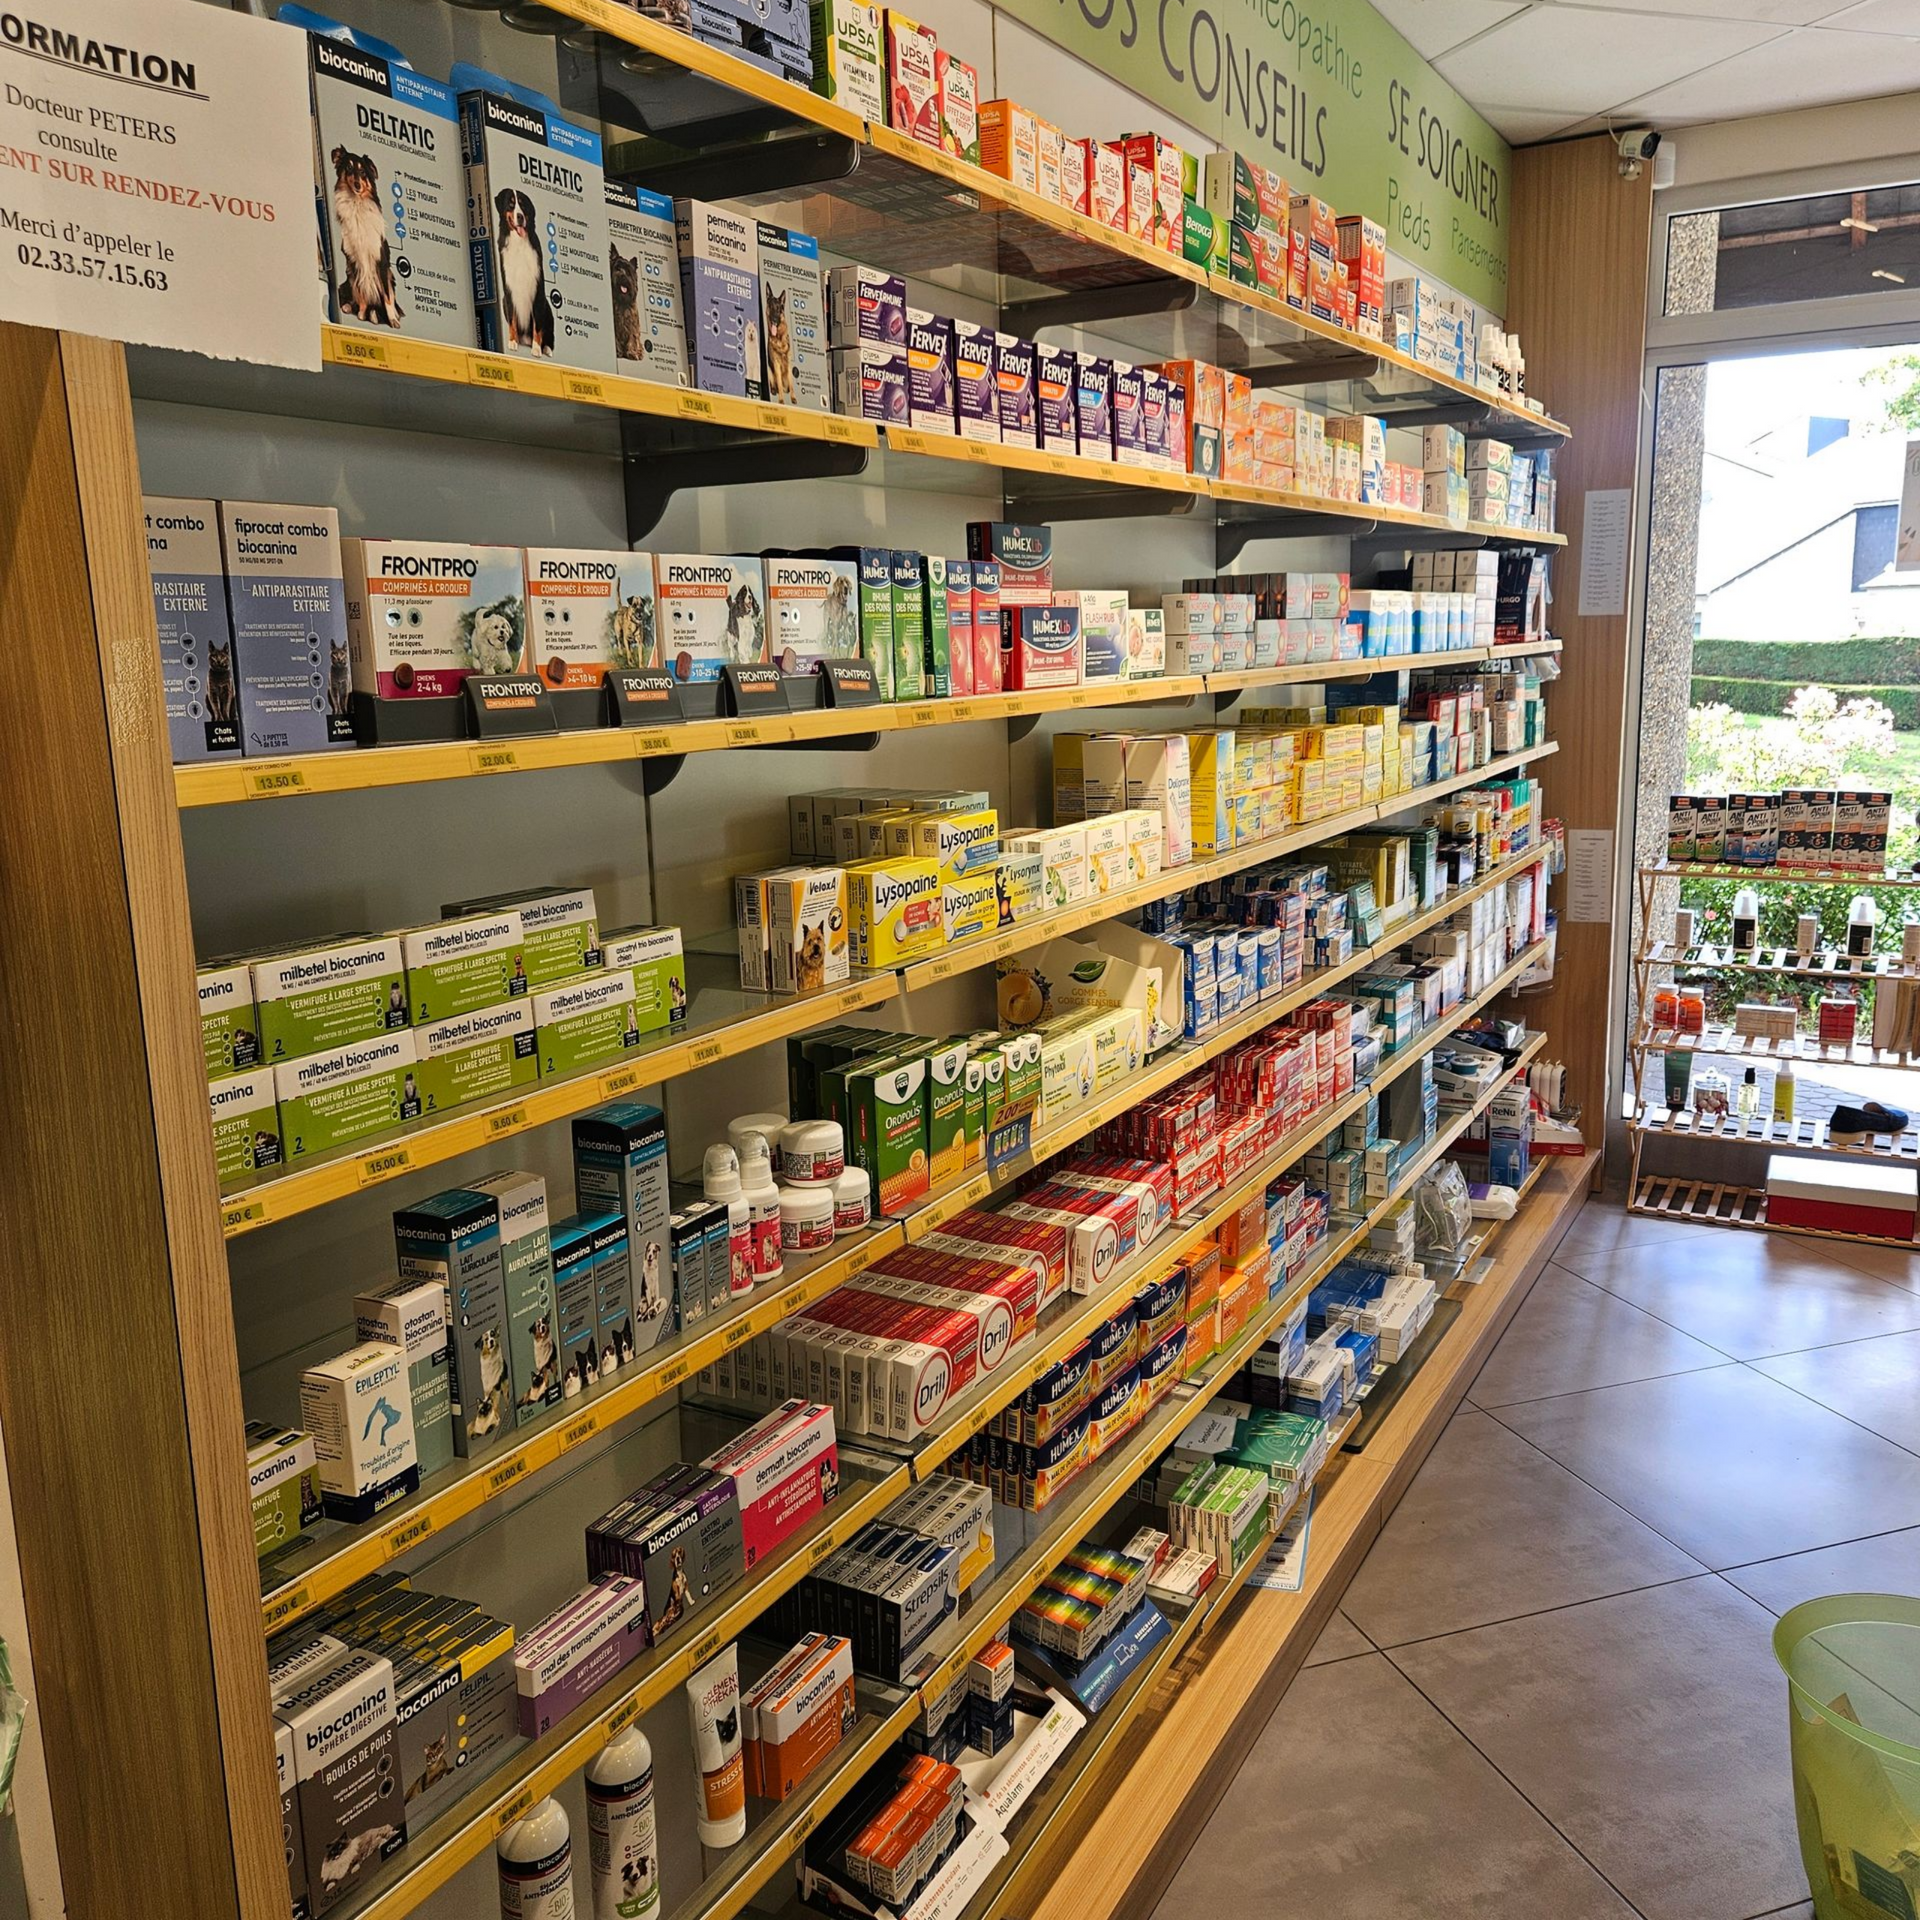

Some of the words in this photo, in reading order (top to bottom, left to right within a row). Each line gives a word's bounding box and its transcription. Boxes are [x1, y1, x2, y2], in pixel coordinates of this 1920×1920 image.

[837, 21, 876, 50] UPSA
[318, 45, 387, 86] biocanina
[900, 41, 930, 67] UPSA
[395, 75, 447, 101] ANTIPARASITAIRE
[397, 83, 424, 100] EXTERNE
[948, 80, 971, 101] UPSA
[1158, 0, 1327, 177] CONSEILS
[5, 83, 83, 123] Docteur
[89, 106, 177, 145] PETERS
[488, 101, 543, 136] biocanina
[356, 103, 435, 151] DELTATIC
[38, 130, 118, 163] consulte
[1388, 79, 1410, 155] SE
[1418, 106, 1498, 227] SOIGNER
[518, 153, 584, 193] DELTATIC
[49, 159, 98, 188] SUR
[101, 170, 276, 222] RENDEZ-VOUS
[418, 210, 456, 229] MOUSTIQUES
[707, 213, 746, 235] permetrix
[1388, 177, 1431, 251] Pieds
[0, 208, 57, 239] Merci
[157, 240, 175, 262] le
[609, 218, 642, 237] PERMETRIX
[643, 227, 673, 244] BIOCANINA
[1185, 215, 1211, 239] Berocca
[708, 229, 746, 253] biocanina
[1452, 217, 1507, 285] Pansements
[17, 244, 169, 292] 02.33.57.15.63
[703, 265, 752, 288] ANTIPARASITAIRES
[727, 283, 752, 300] EXTERNES
[345, 344, 367, 357] 9.60
[368, 350, 376, 359] €
[479, 367, 502, 381] 25.00
[156, 516, 205, 532] combo
[234, 518, 284, 538] fiprocat
[287, 523, 328, 538] combo
[237, 538, 297, 556] biocanina
[1002, 536, 1031, 552] HUMEX
[381, 555, 476, 578] FRONTPRO
[539, 561, 616, 580] FRONTPRO
[669, 565, 732, 583] FRONTPRO
[777, 569, 832, 584] FRONTPRO
[863, 565, 889, 580] HUMEX
[895, 567, 921, 580] HUMEX
[252, 584, 329, 598] ANTIPARASITAIRE
[382, 581, 427, 594] COMPRIMÉS
[428, 582, 434, 593] À
[435, 582, 468, 593] CROQUER
[872, 593, 890, 602] RHUME
[1500, 595, 1520, 603] URGO
[164, 599, 208, 612] EXTERNE
[293, 599, 331, 612] EXTERNE
[865, 603, 874, 613] DES
[875, 602, 891, 613] FOINS
[417, 683, 431, 693] 2-4
[432, 682, 442, 694] kg
[643, 739, 661, 751] 38.00
[734, 728, 750, 740] 43.00
[481, 754, 505, 768] 32.00
[505, 754, 512, 764] €
[259, 774, 289, 790] 13.50
[291, 774, 300, 786] €
[1168, 778, 1189, 790] Doliprane
[941, 821, 995, 850] Lysopaïne
[424, 932, 464, 952] milbetel
[465, 923, 509, 942] biocanina
[647, 934, 674, 947] biocanina
[279, 960, 328, 982] milbetel
[329, 950, 386, 975] biocanina
[617, 952, 633, 963] chien
[290, 995, 327, 1010] VERMIFUGE
[328, 991, 333, 1002] À
[334, 987, 355, 1001] LARGE
[355, 981, 382, 995] SPECTRE
[1058, 996, 1085, 1006] GORGE
[1086, 997, 1121, 1007] SENSIBLE
[1071, 988, 1107, 998] GOMMES
[428, 1024, 471, 1044] milbetel
[472, 1009, 522, 1031] biocanina
[274, 1038, 283, 1053] 2
[298, 1057, 345, 1081] milbetel
[346, 1043, 399, 1067] biocanina
[1044, 1058, 1066, 1078] Phytoxil
[886, 1102, 922, 1130] OROPOLIS
[995, 1103, 1018, 1126] 2.00
[629, 1129, 664, 1151] biocanina
[370, 1158, 396, 1173] 15.00
[397, 1154, 405, 1166] €
[502, 1194, 544, 1221] biocanina
[451, 1213, 496, 1240] biocanina
[594, 1228, 626, 1249] biocanina
[460, 1254, 473, 1267] LAIT
[460, 1251, 500, 1276] AURICULAIRE
[557, 1245, 590, 1268] biocanina
[1096, 1240, 1116, 1269] Drill
[1151, 1288, 1177, 1317] HUMEX
[404, 1308, 435, 1331] otostan
[405, 1316, 443, 1341] biocanina
[983, 1319, 1009, 1353] Drill
[1100, 1320, 1128, 1354] HUMEX
[356, 1362, 400, 1394] ÉPILEPTYL
[1050, 1365, 1082, 1401] HUMEX
[919, 1377, 947, 1409] Drill
[1101, 1380, 1130, 1416] HUMEX
[371, 1453, 403, 1475] épileptique
[755, 1456, 785, 1483] dermatt
[785, 1429, 821, 1460] biocanina
[493, 1467, 517, 1486] 11.00
[767, 1467, 816, 1509] ANTI-INFLAMMATOIRE
[374, 1485, 407, 1513] BOIRON
[775, 1491, 817, 1525] ANTIHISTAMINIQUE
[394, 1526, 419, 1547] 14.70
[419, 1522, 428, 1532] €
[647, 1511, 699, 1556] biocanina
[903, 1566, 951, 1621] Strepsils
[265, 1603, 289, 1623] 7.90
[290, 1598, 298, 1609] €
[540, 1658, 556, 1678] mal
[556, 1649, 571, 1668] des
[571, 1621, 607, 1659] transports
[607, 1595, 639, 1627] biocanina
[459, 1671, 491, 1701] FÉLIPIL
[796, 1669, 836, 1714] biocanina
[306, 1686, 387, 1751] biocanina
[809, 1695, 837, 1729] ARTHROPLUS
[319, 1724, 349, 1757] SPHÈRE
[350, 1703, 387, 1735] DIGESTIVE
[326, 1759, 358, 1786] BOULES
[359, 1751, 367, 1767] DE
[368, 1729, 392, 1755] POILS
[994, 1781, 1024, 1818] Aqualarm
